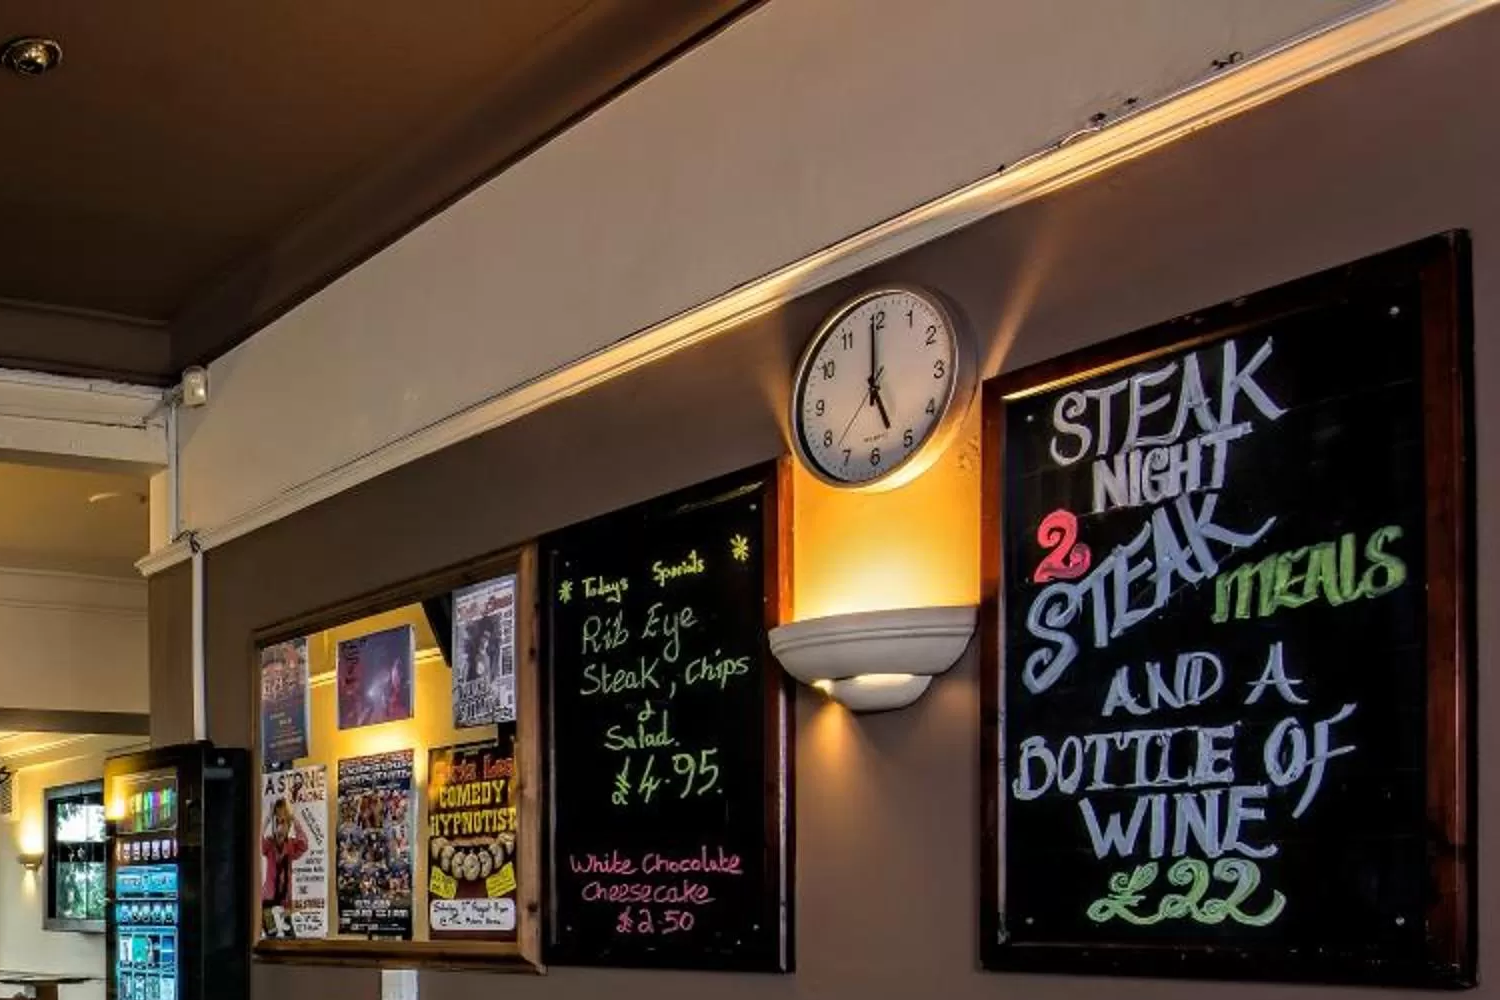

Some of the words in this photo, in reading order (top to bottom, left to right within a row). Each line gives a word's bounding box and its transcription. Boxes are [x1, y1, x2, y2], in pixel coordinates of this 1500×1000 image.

[869, 311, 885, 330] 12
[905, 310, 913, 328] 1
[842, 332, 853, 350] 11
[925, 325, 937, 345] 2
[819, 361, 835, 380] 10
[933, 360, 945, 379] 3
[815, 400, 825, 416] 9
[925, 398, 935, 415] 4
[1050, 336, 1290, 466] STEAK
[823, 430, 833, 448] 8
[903, 429, 913, 448] 5
[843, 450, 852, 467] 7
[869, 448, 880, 466] 6
[1092, 421, 1254, 514] NIGHT
[1034, 508, 1092, 584] 2
[581, 575, 629, 603] Todays
[652, 549, 705, 587] Specials
[1022, 493, 1278, 695] STEAK
[1210, 524, 1408, 626] MEALS
[581, 608, 629, 654] Rib
[641, 602, 698, 663] Eye
[685, 648, 750, 690] Chips
[1101, 650, 1224, 717] AND
[1244, 640, 1310, 706] A
[1012, 720, 1243, 801] BOTTLE
[1264, 703, 1357, 819] OF
[264, 777, 276, 796] A
[440, 780, 506, 808] COMEDY
[430, 808, 517, 837] HYPNOTIST
[1078, 783, 1279, 859] WINE
[570, 849, 638, 875] White
[642, 845, 743, 875] Chocolate
[581, 879, 716, 905] Cheesecake
[1087, 856, 1287, 927] £22
